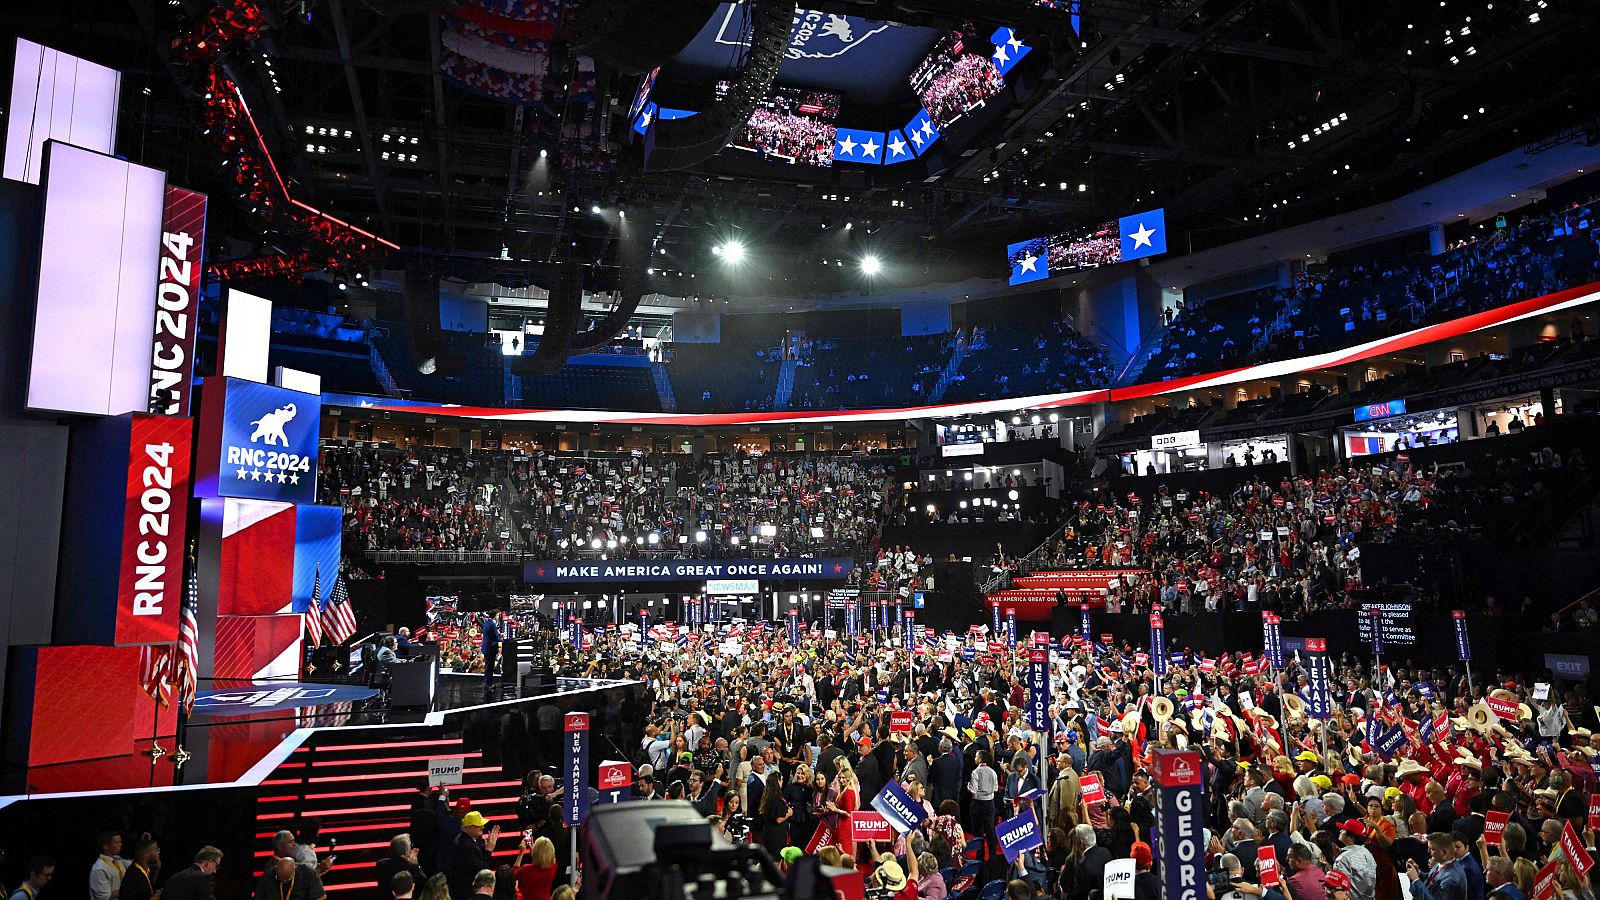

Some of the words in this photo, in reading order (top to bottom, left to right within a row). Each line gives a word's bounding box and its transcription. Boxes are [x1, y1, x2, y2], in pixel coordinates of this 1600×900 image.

[155, 231, 194, 339] 2024
[1369, 403, 1390, 418] CNN
[227, 446, 265, 468] RNC
[267, 451, 310, 473] 2024
[139, 442, 174, 536] 2024
[133, 540, 168, 615] RNC
[557, 567, 599, 577] MAKE
[604, 565, 671, 576] AMERICA
[676, 565, 723, 575] GREAT
[727, 565, 767, 575] ONCE
[771, 564, 822, 574] AGAIN!
[708, 582, 756, 591] NEWSMAX
[1034, 664, 1044, 688] NEW
[1556, 661, 1582, 672] EXIT
[1310, 656, 1322, 713] TEXAS
[1322, 656, 1330, 713] TEXAS
[1035, 693, 1044, 728] YORK
[1490, 702, 1516, 714] TRUMP
[572, 732, 581, 753] NEW
[1369, 719, 1377, 746] TRUMP
[1381, 730, 1403, 751] TRUMP
[430, 766, 460, 775] TRUMP
[572, 758, 580, 821] HAMPSHIRE
[1081, 783, 1100, 793] TRUMP
[883, 789, 918, 823] TRUMP
[853, 820, 889, 829] TRUMP
[1001, 822, 1034, 846] TRUMP
[1485, 821, 1505, 831] TRUMP
[1563, 831, 1585, 871] TRUMP
[1105, 872, 1131, 884] TRUMP
[1534, 872, 1554, 892] TRUMP
